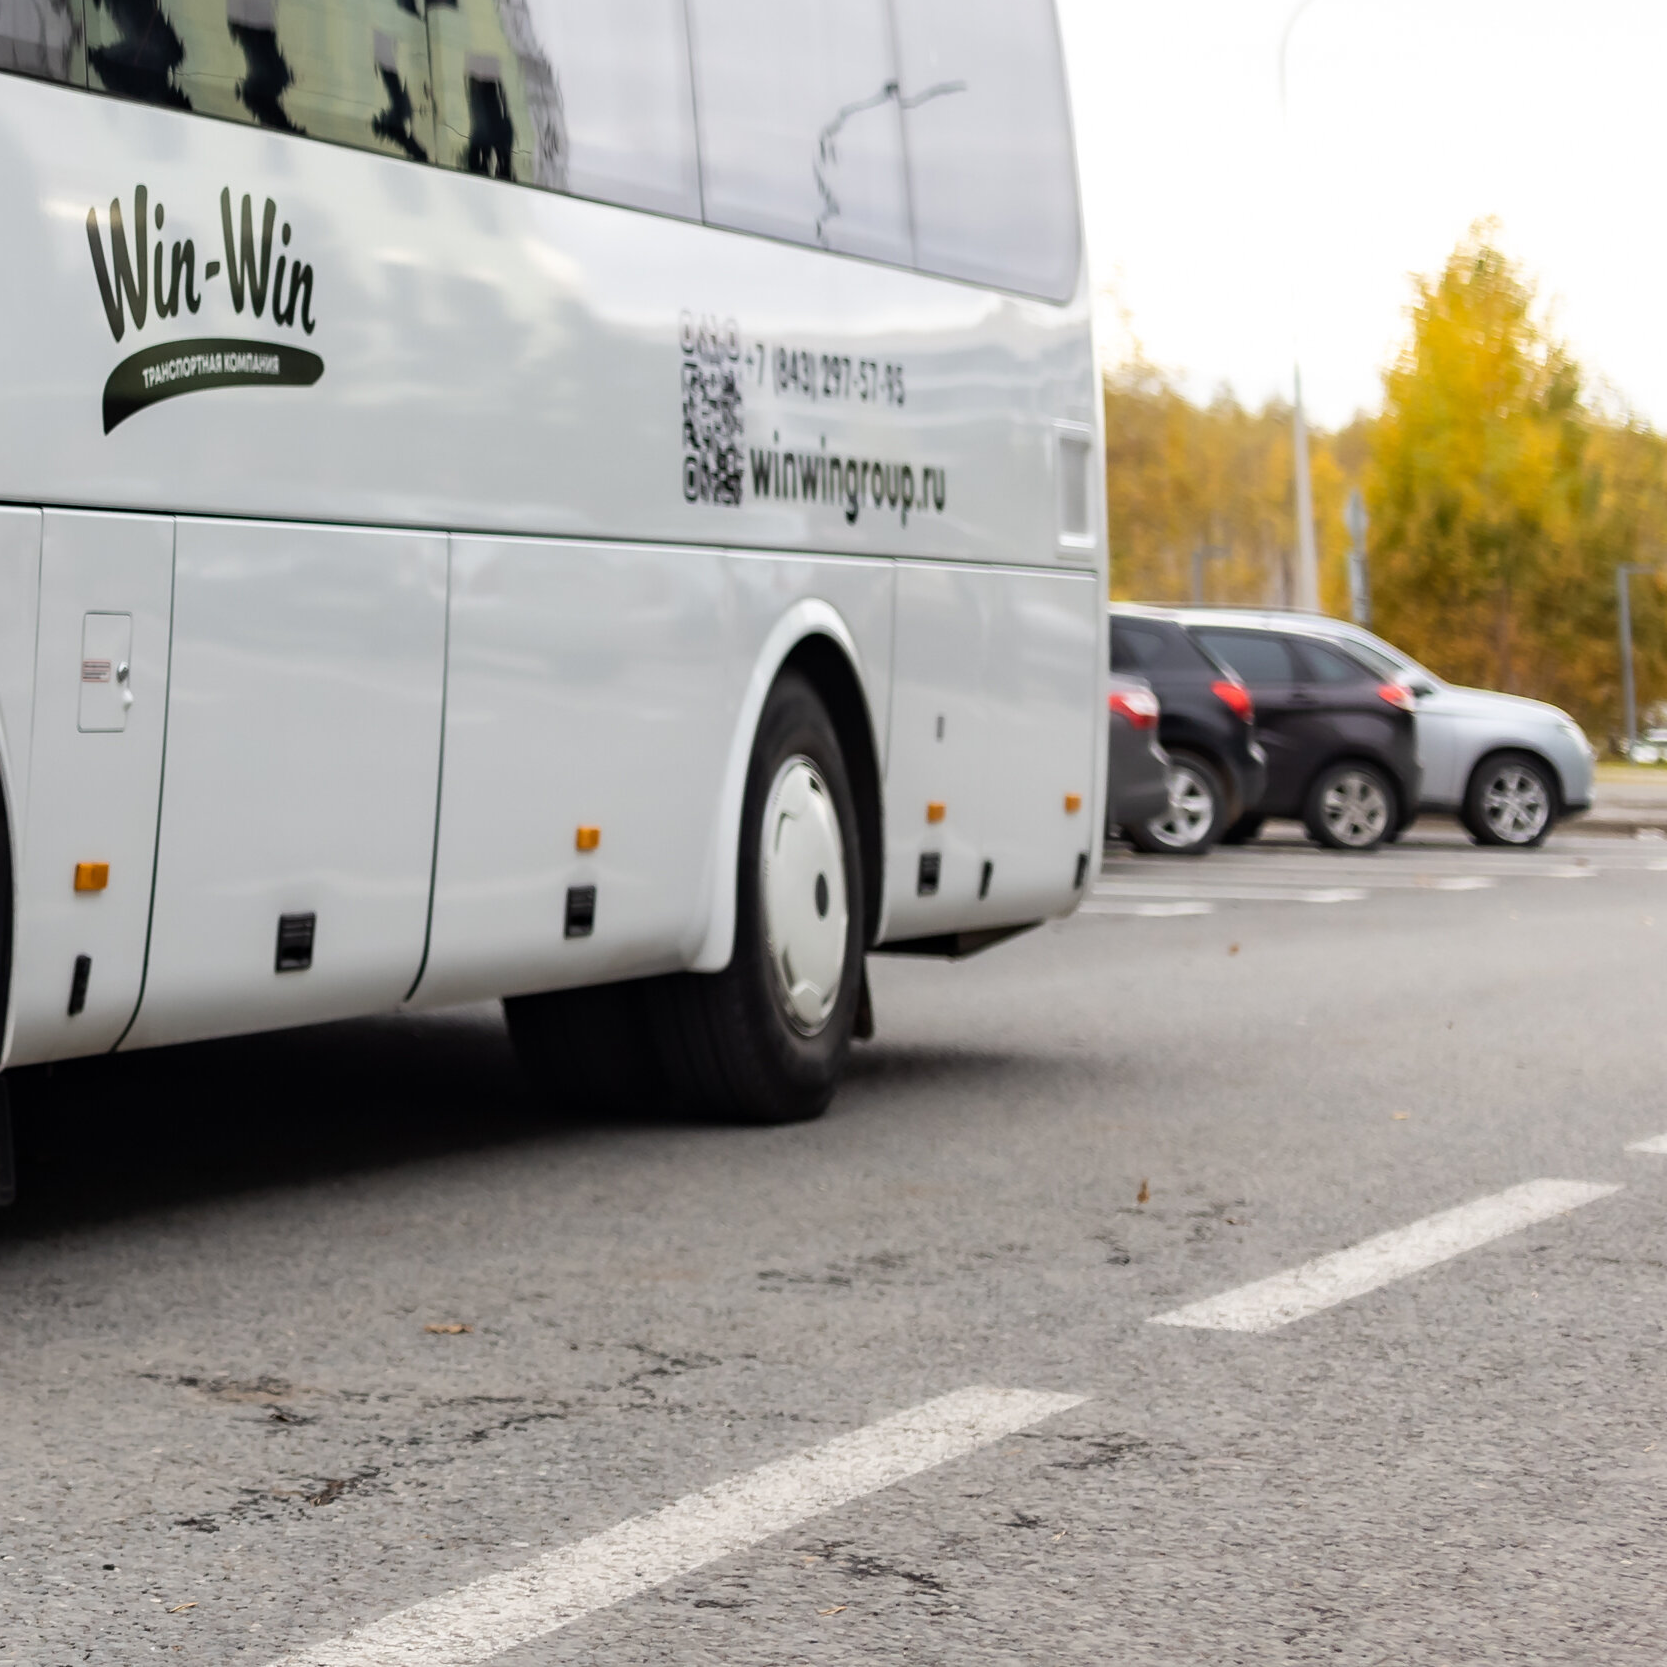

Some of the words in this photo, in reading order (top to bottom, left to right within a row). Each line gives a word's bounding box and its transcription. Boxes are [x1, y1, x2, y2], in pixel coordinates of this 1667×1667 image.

[86, 184, 315, 343] Win-Win
[142, 353, 222, 388] ТРАНСПОРТНАЯ
[224, 352, 280, 376] КОМПАНИЯ
[750, 429, 946, 529] winwingroup.ru
